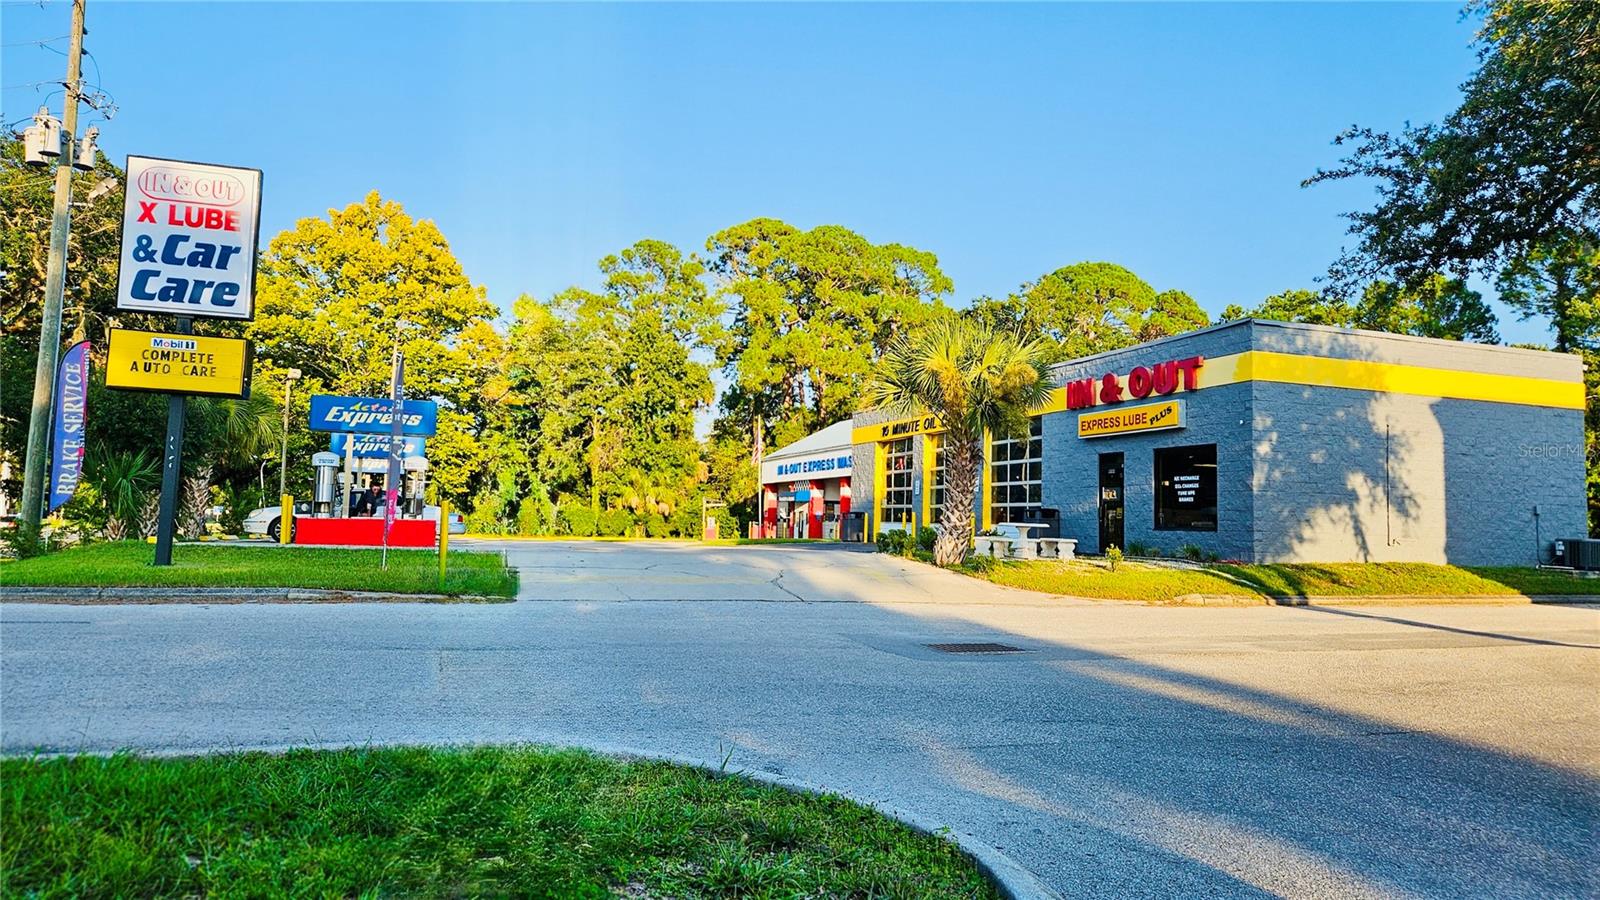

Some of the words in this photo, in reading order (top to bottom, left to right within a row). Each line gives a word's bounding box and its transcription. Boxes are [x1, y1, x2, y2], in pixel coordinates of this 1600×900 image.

[137, 201, 158, 224] X
[168, 204, 241, 232] LUBE
[130, 269, 240, 307] Care
[153, 338, 183, 349] Mobil
[142, 349, 214, 365] COMPLETE
[182, 365, 217, 378] CARE
[1066, 377, 1096, 410] IN
[1100, 372, 1124, 404] &
[1128, 355, 1205, 399] OUT
[63, 363, 84, 437] SERVICE
[892, 420, 920, 435] MINUTE
[924, 417, 936, 430] OIL
[1081, 417, 1121, 431] EXPRESS
[1123, 412, 1148, 427] LUBE
[1149, 406, 1172, 425] PLUS
[56, 439, 80, 495] BRAKE
[803, 458, 835, 473] EXPRESS
